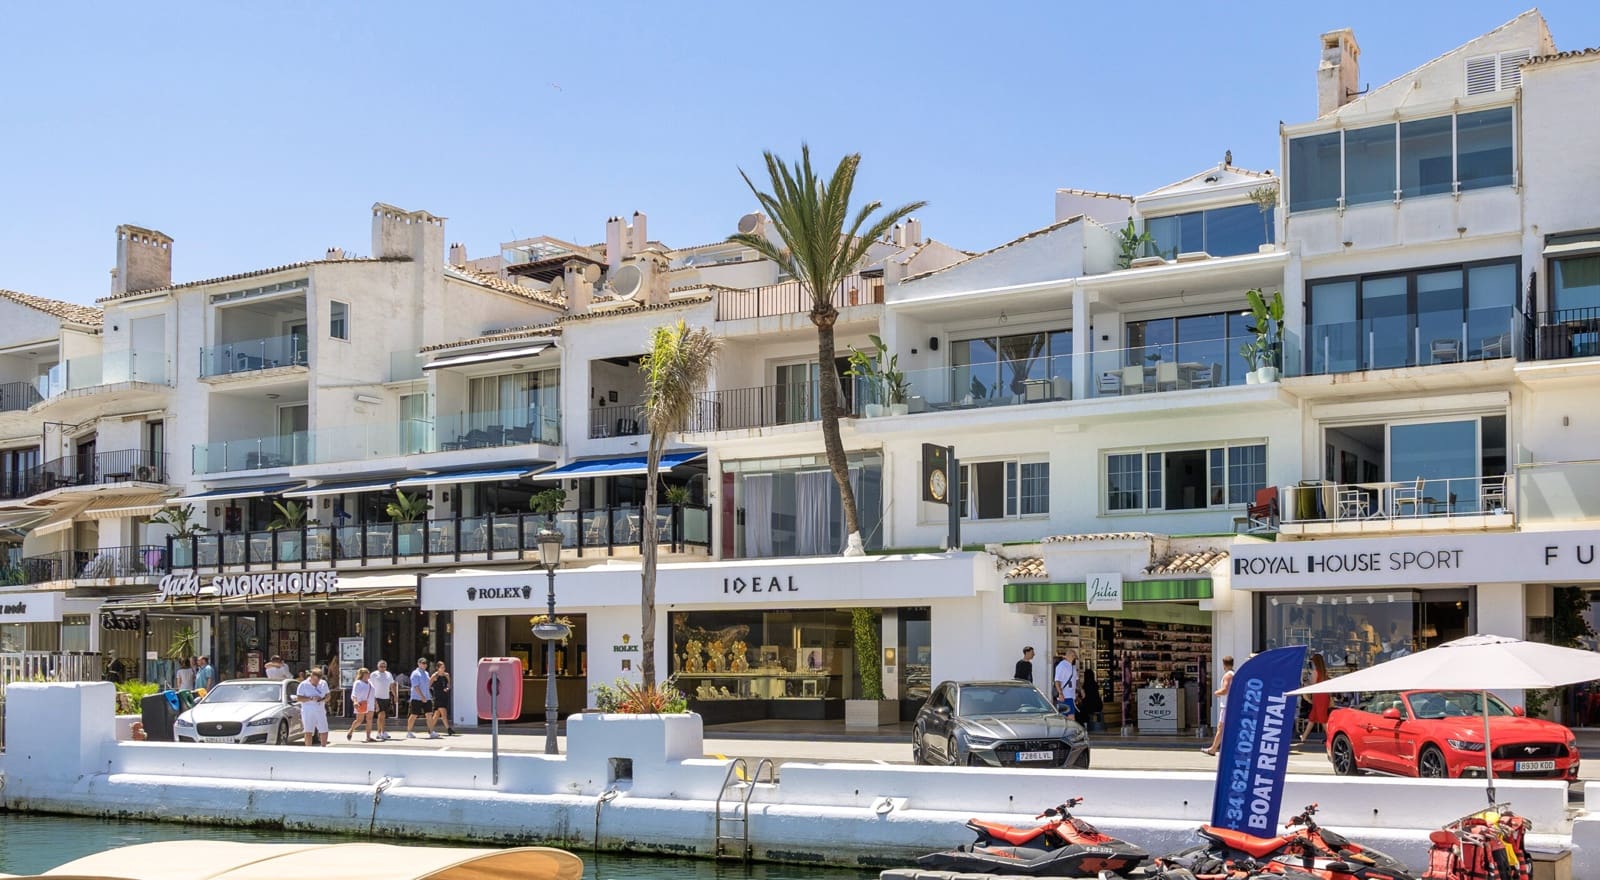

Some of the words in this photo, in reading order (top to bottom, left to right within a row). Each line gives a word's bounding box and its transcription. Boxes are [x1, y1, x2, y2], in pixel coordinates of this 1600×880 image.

[1234, 556, 1299, 575] ROYAL
[1307, 553, 1381, 573] HOUSE
[1389, 549, 1463, 571] SPORT
[212, 571, 337, 596] SMOKEHOUSE
[479, 587, 521, 599] ROLEX
[723, 575, 799, 594] IDEAL
[1243, 678, 1263, 712] 720
[1237, 718, 1257, 753] 022
[1257, 691, 1287, 771] RENTAL
[1231, 758, 1251, 793] 621
[1248, 774, 1274, 830] BOAT
